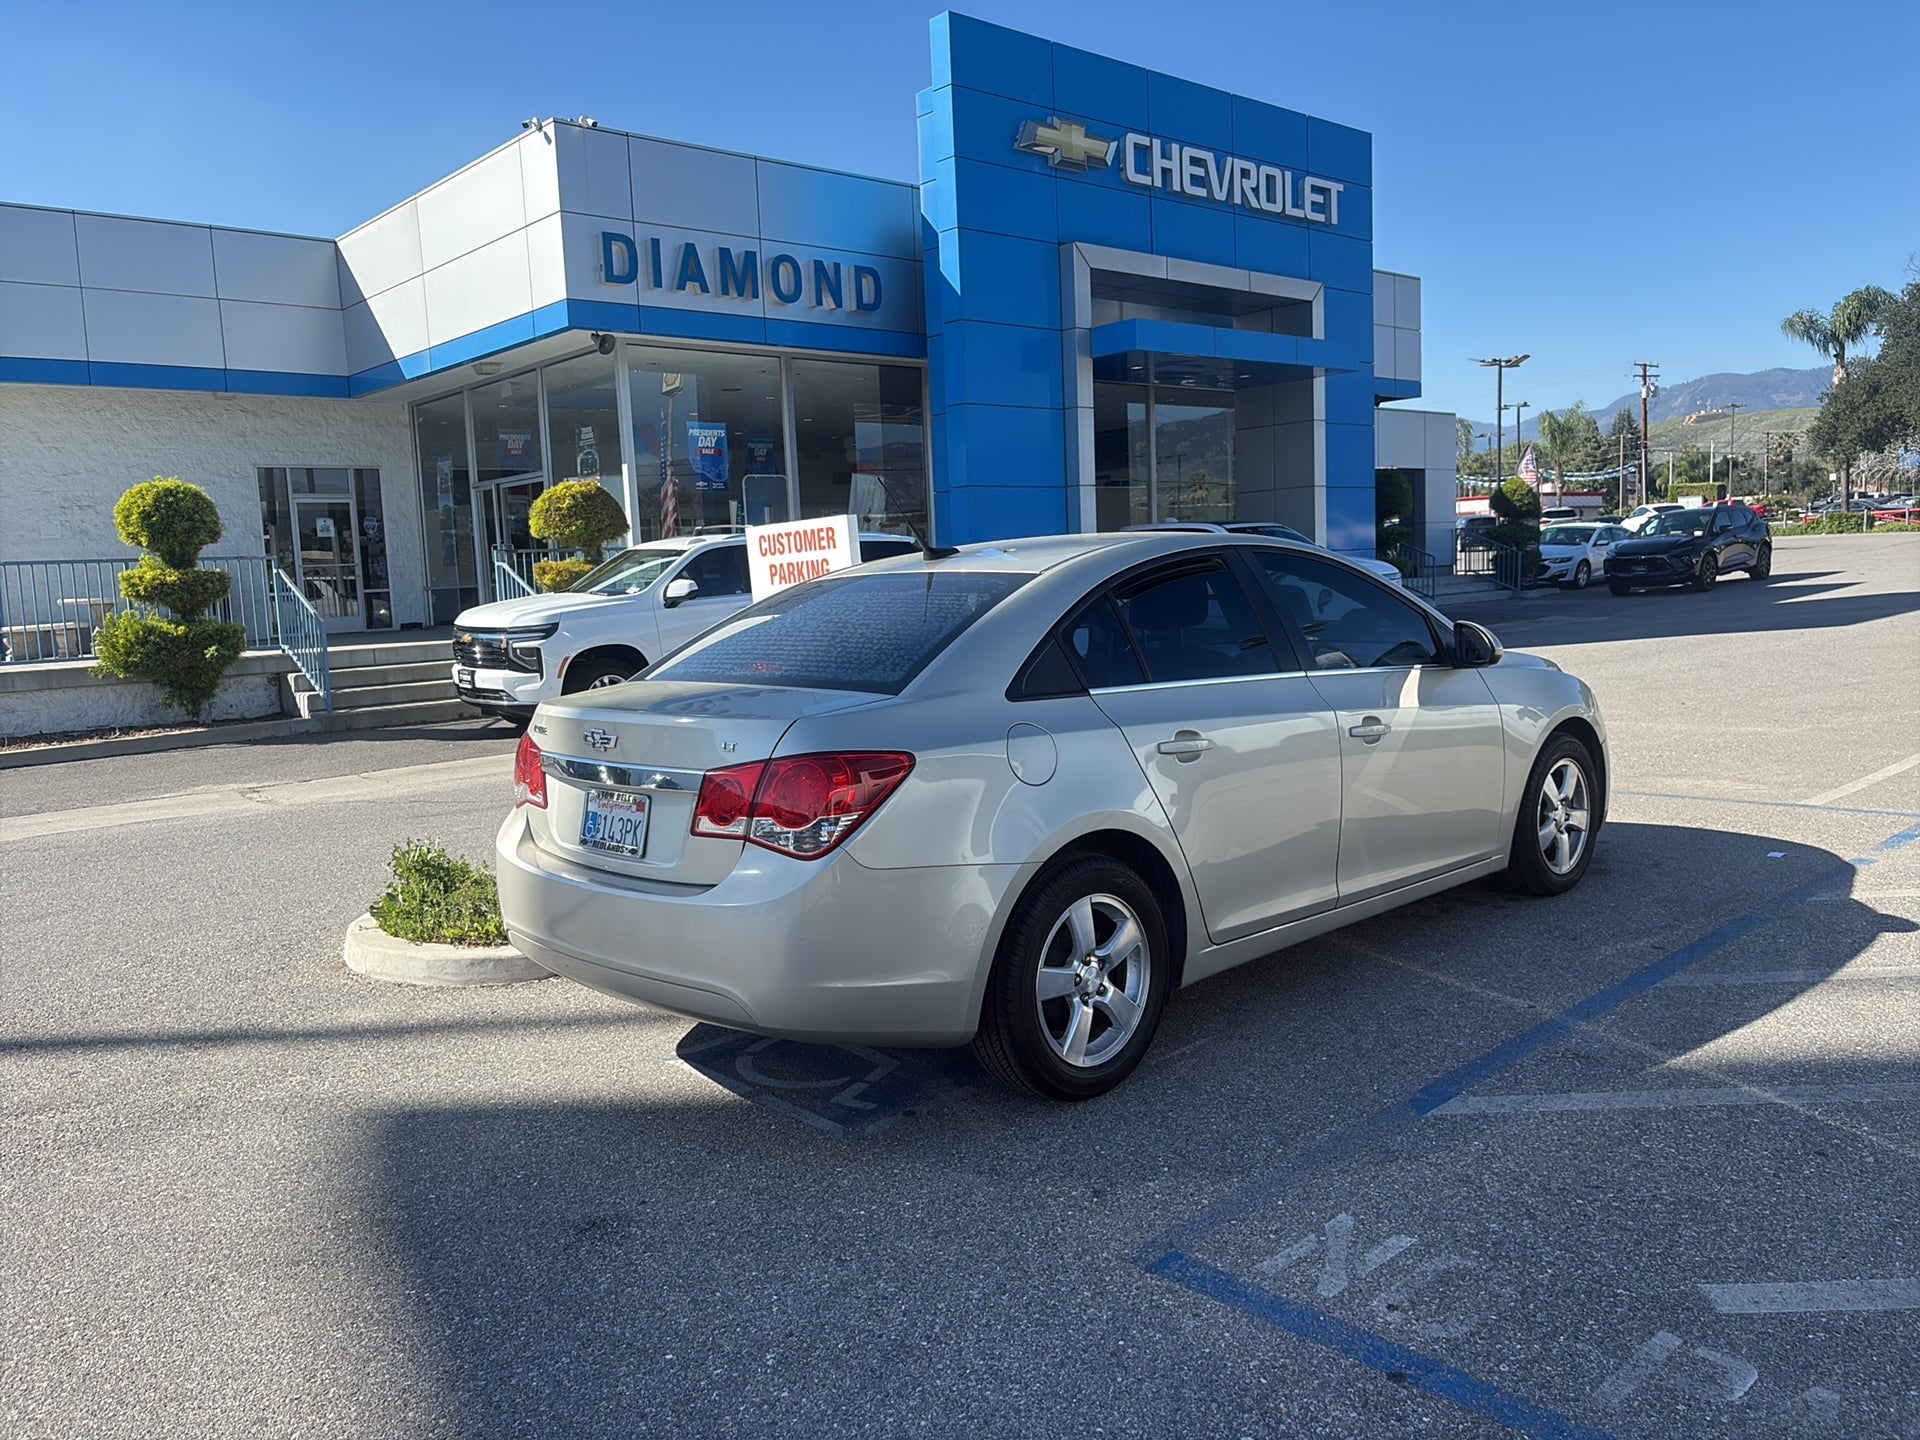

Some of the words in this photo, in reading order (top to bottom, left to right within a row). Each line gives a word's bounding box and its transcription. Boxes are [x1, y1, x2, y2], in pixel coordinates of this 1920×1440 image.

[1123, 132, 1344, 225] CHEVROLET
[599, 231, 883, 312] DIAMOND
[689, 428, 725, 437] PRESIDENTS
[508, 440, 524, 449] DAY
[698, 436, 717, 447] DAY
[754, 448, 767, 456] DAY
[758, 526, 837, 557] CUSTOMER
[769, 558, 831, 585] PARKING
[592, 840, 625, 854] REDLANDS
